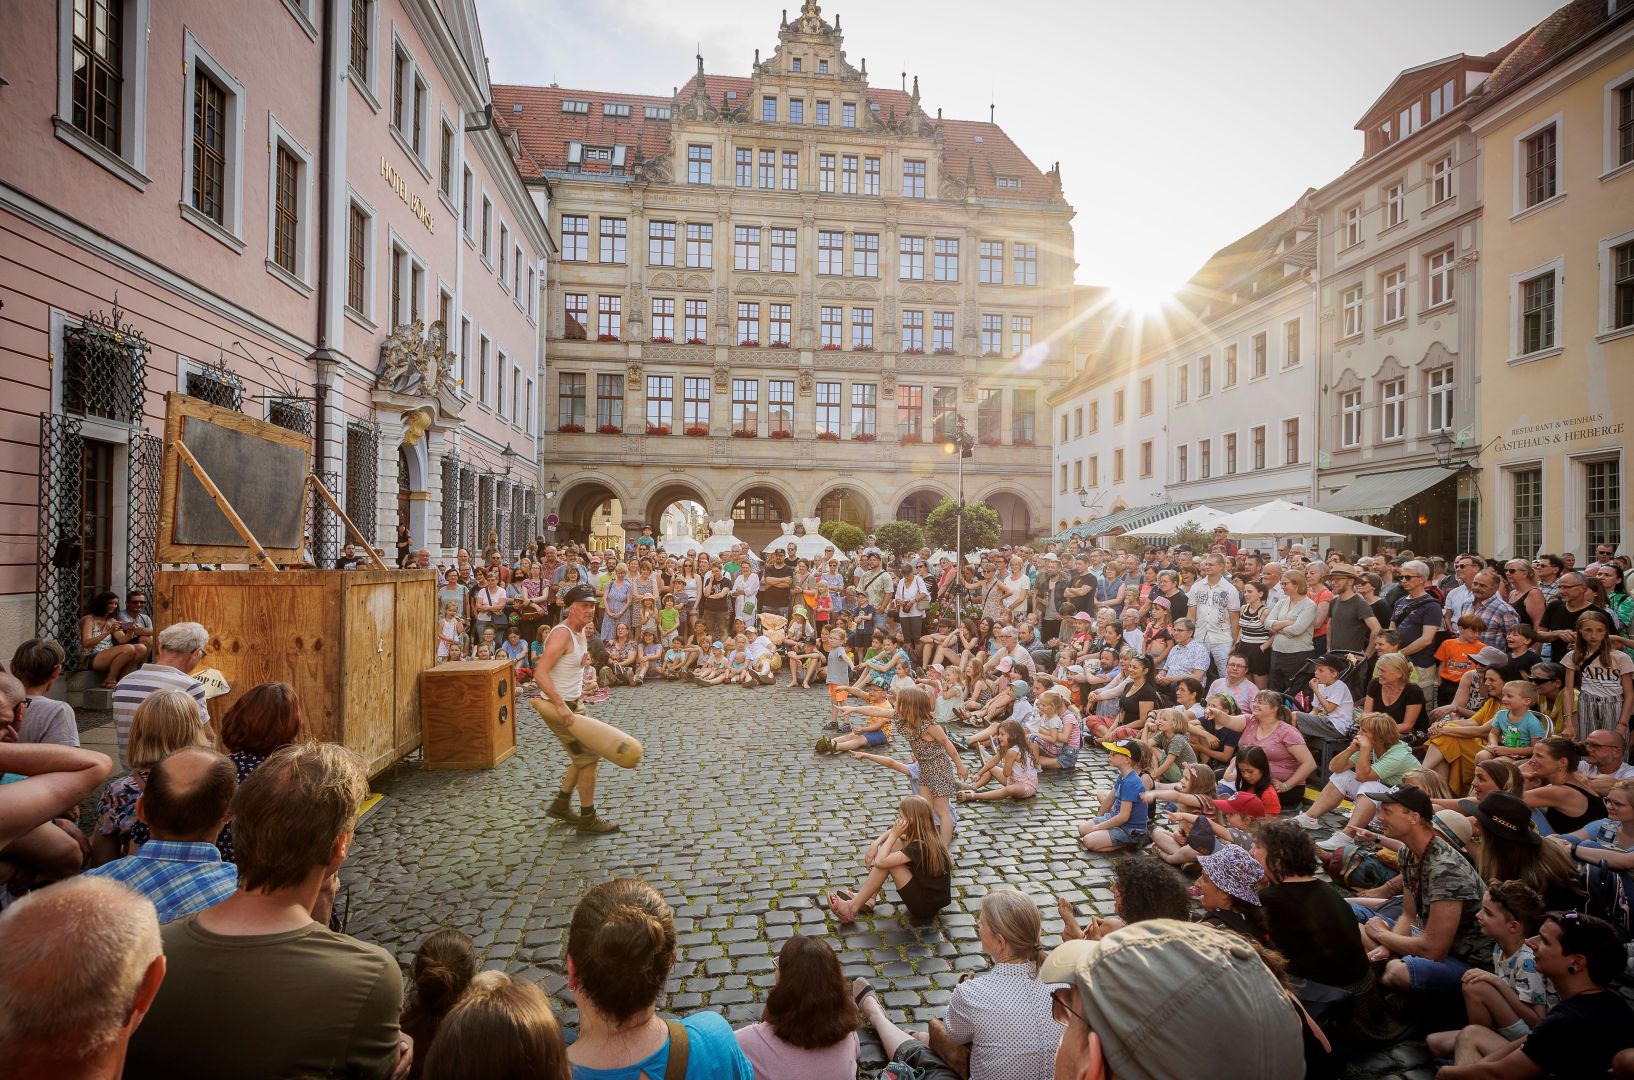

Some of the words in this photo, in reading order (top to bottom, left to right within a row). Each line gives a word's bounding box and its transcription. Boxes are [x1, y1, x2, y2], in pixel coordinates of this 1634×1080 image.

[381, 156, 408, 205] HOTEL
[410, 192, 434, 235] BÖRSE
[1511, 422, 1553, 436] RESTAURANT
[1555, 421, 1561, 429] &
[1562, 413, 1603, 427] WEINHAUS
[1552, 433, 1562, 444] &
[1564, 423, 1625, 442] HERBERGE
[193, 675, 209, 684] OP
[1583, 667, 1621, 681] ARIS
